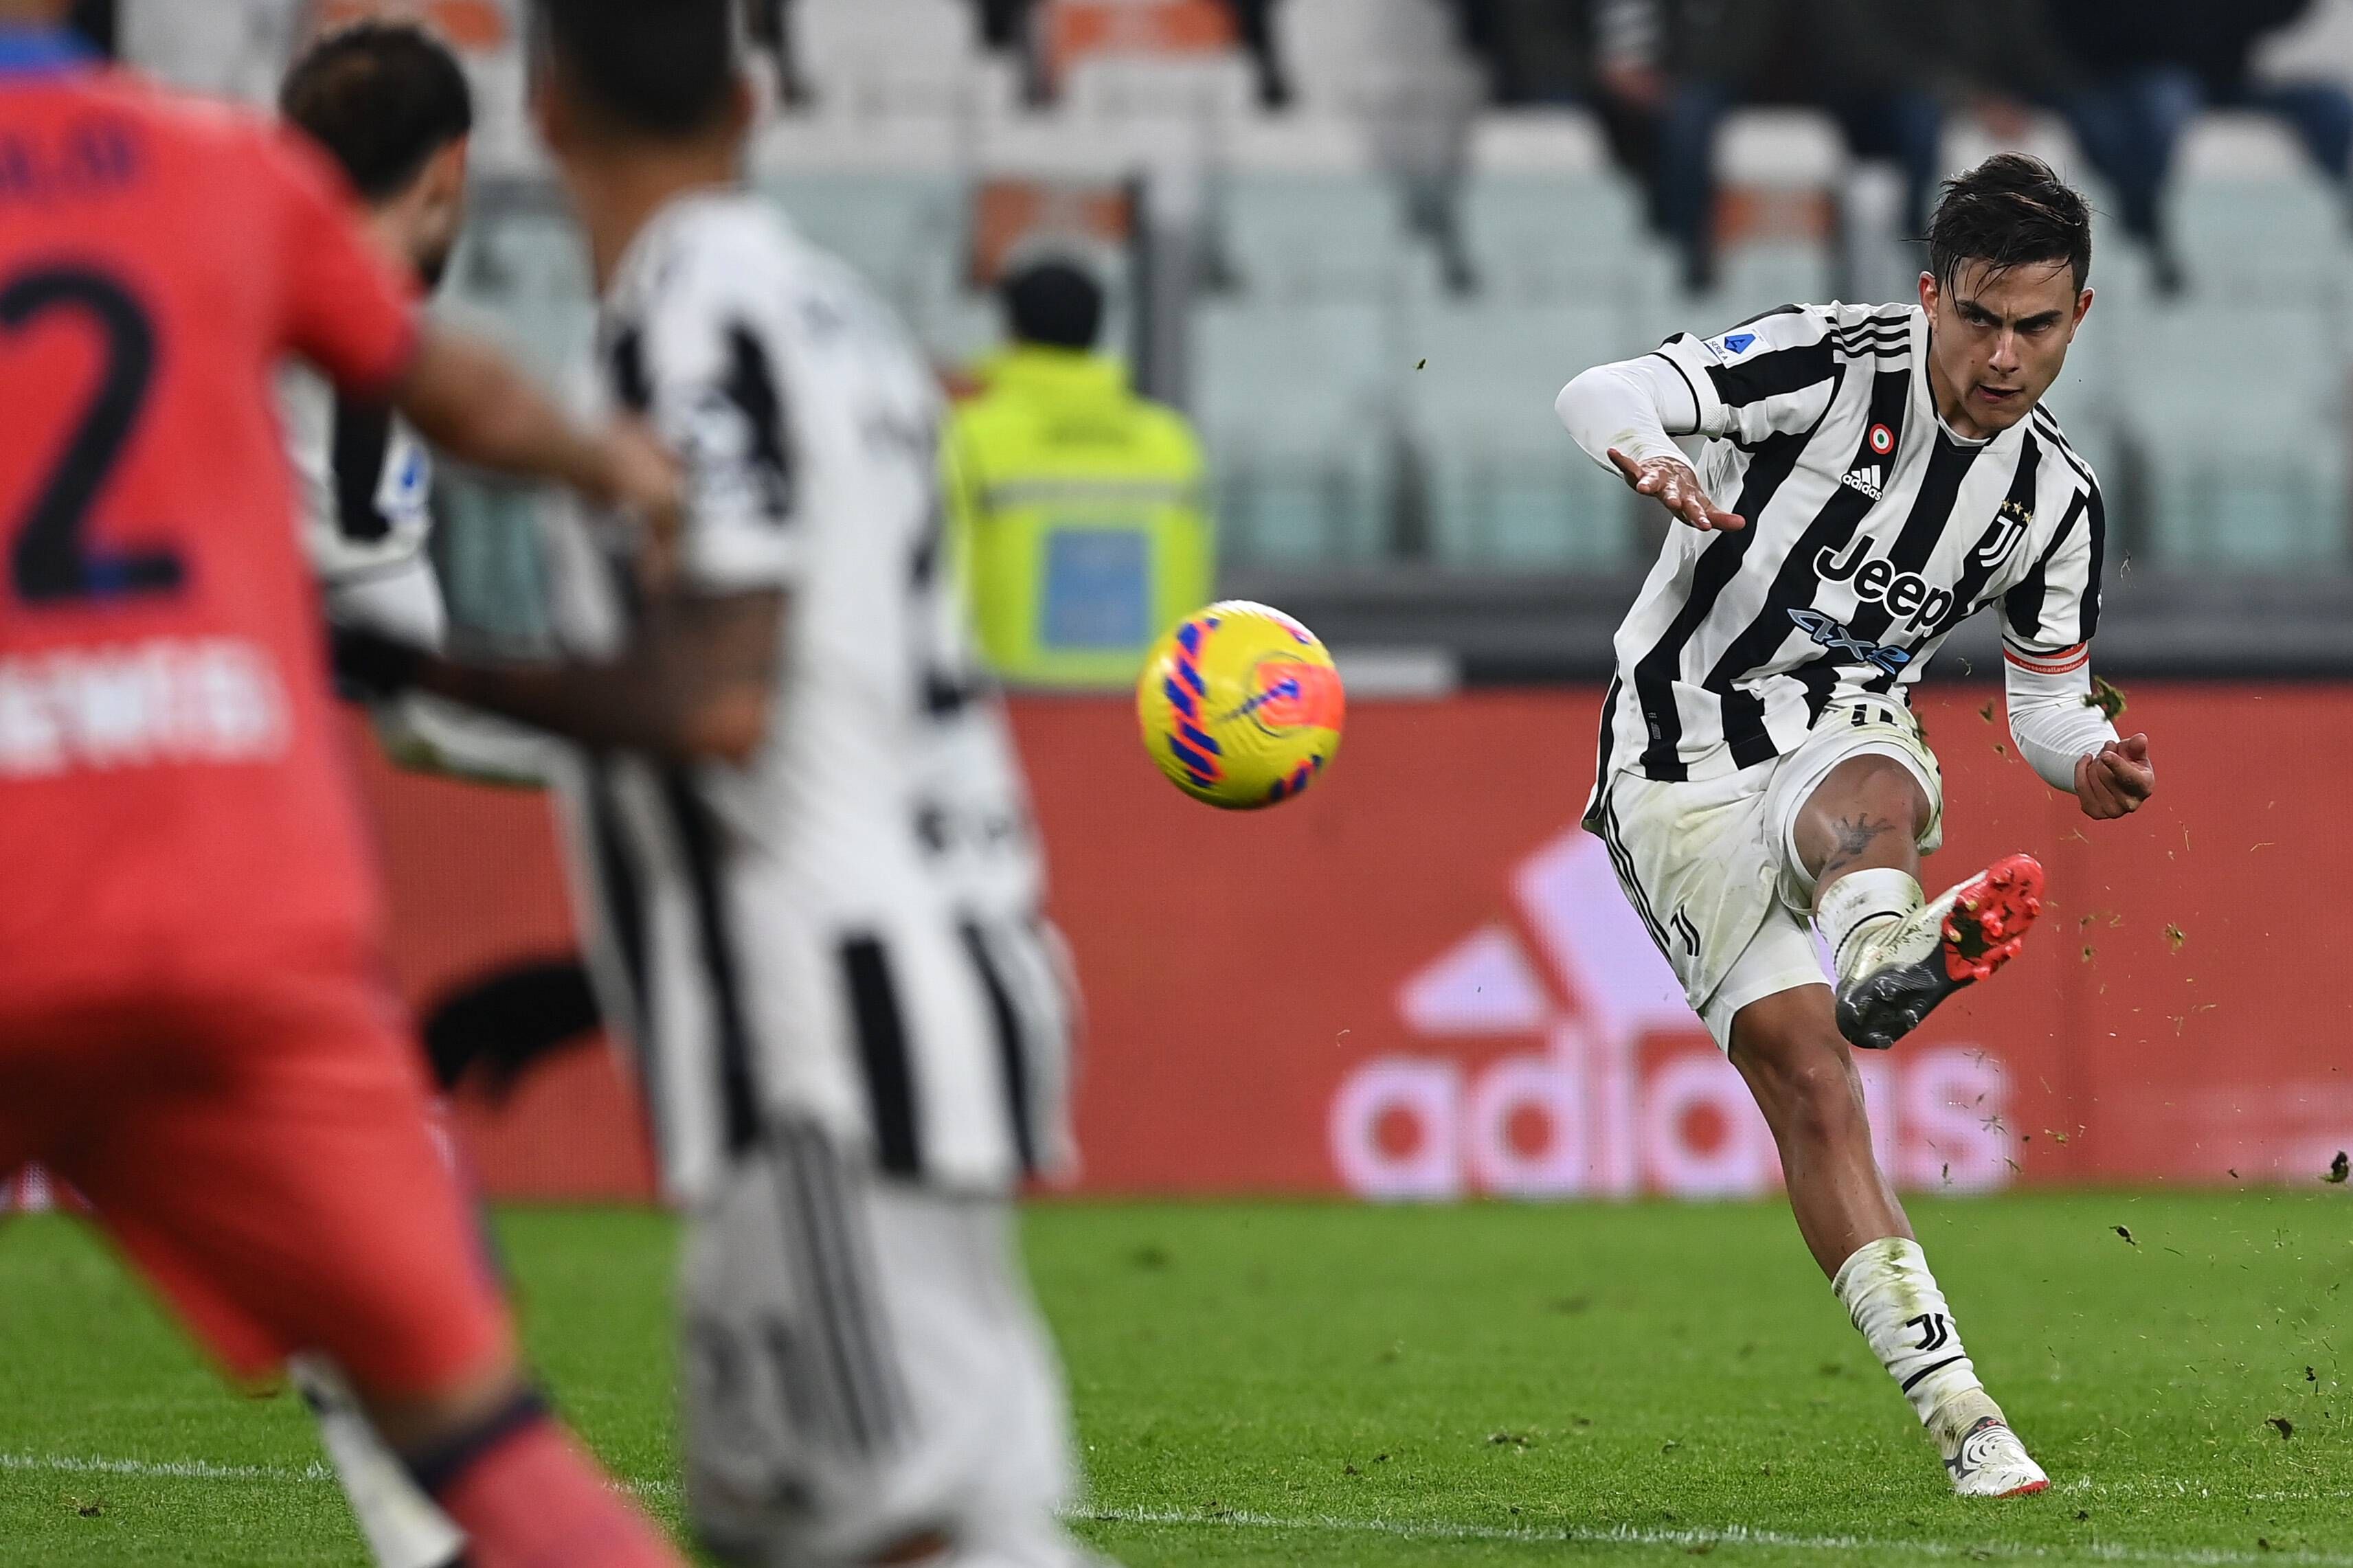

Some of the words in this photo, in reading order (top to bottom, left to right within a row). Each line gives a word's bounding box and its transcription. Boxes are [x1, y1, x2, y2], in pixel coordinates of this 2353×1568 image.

[1709, 341, 1726, 355] SERIE
[1842, 474, 1882, 501] adidas
[1814, 534, 1954, 635] Jeep
